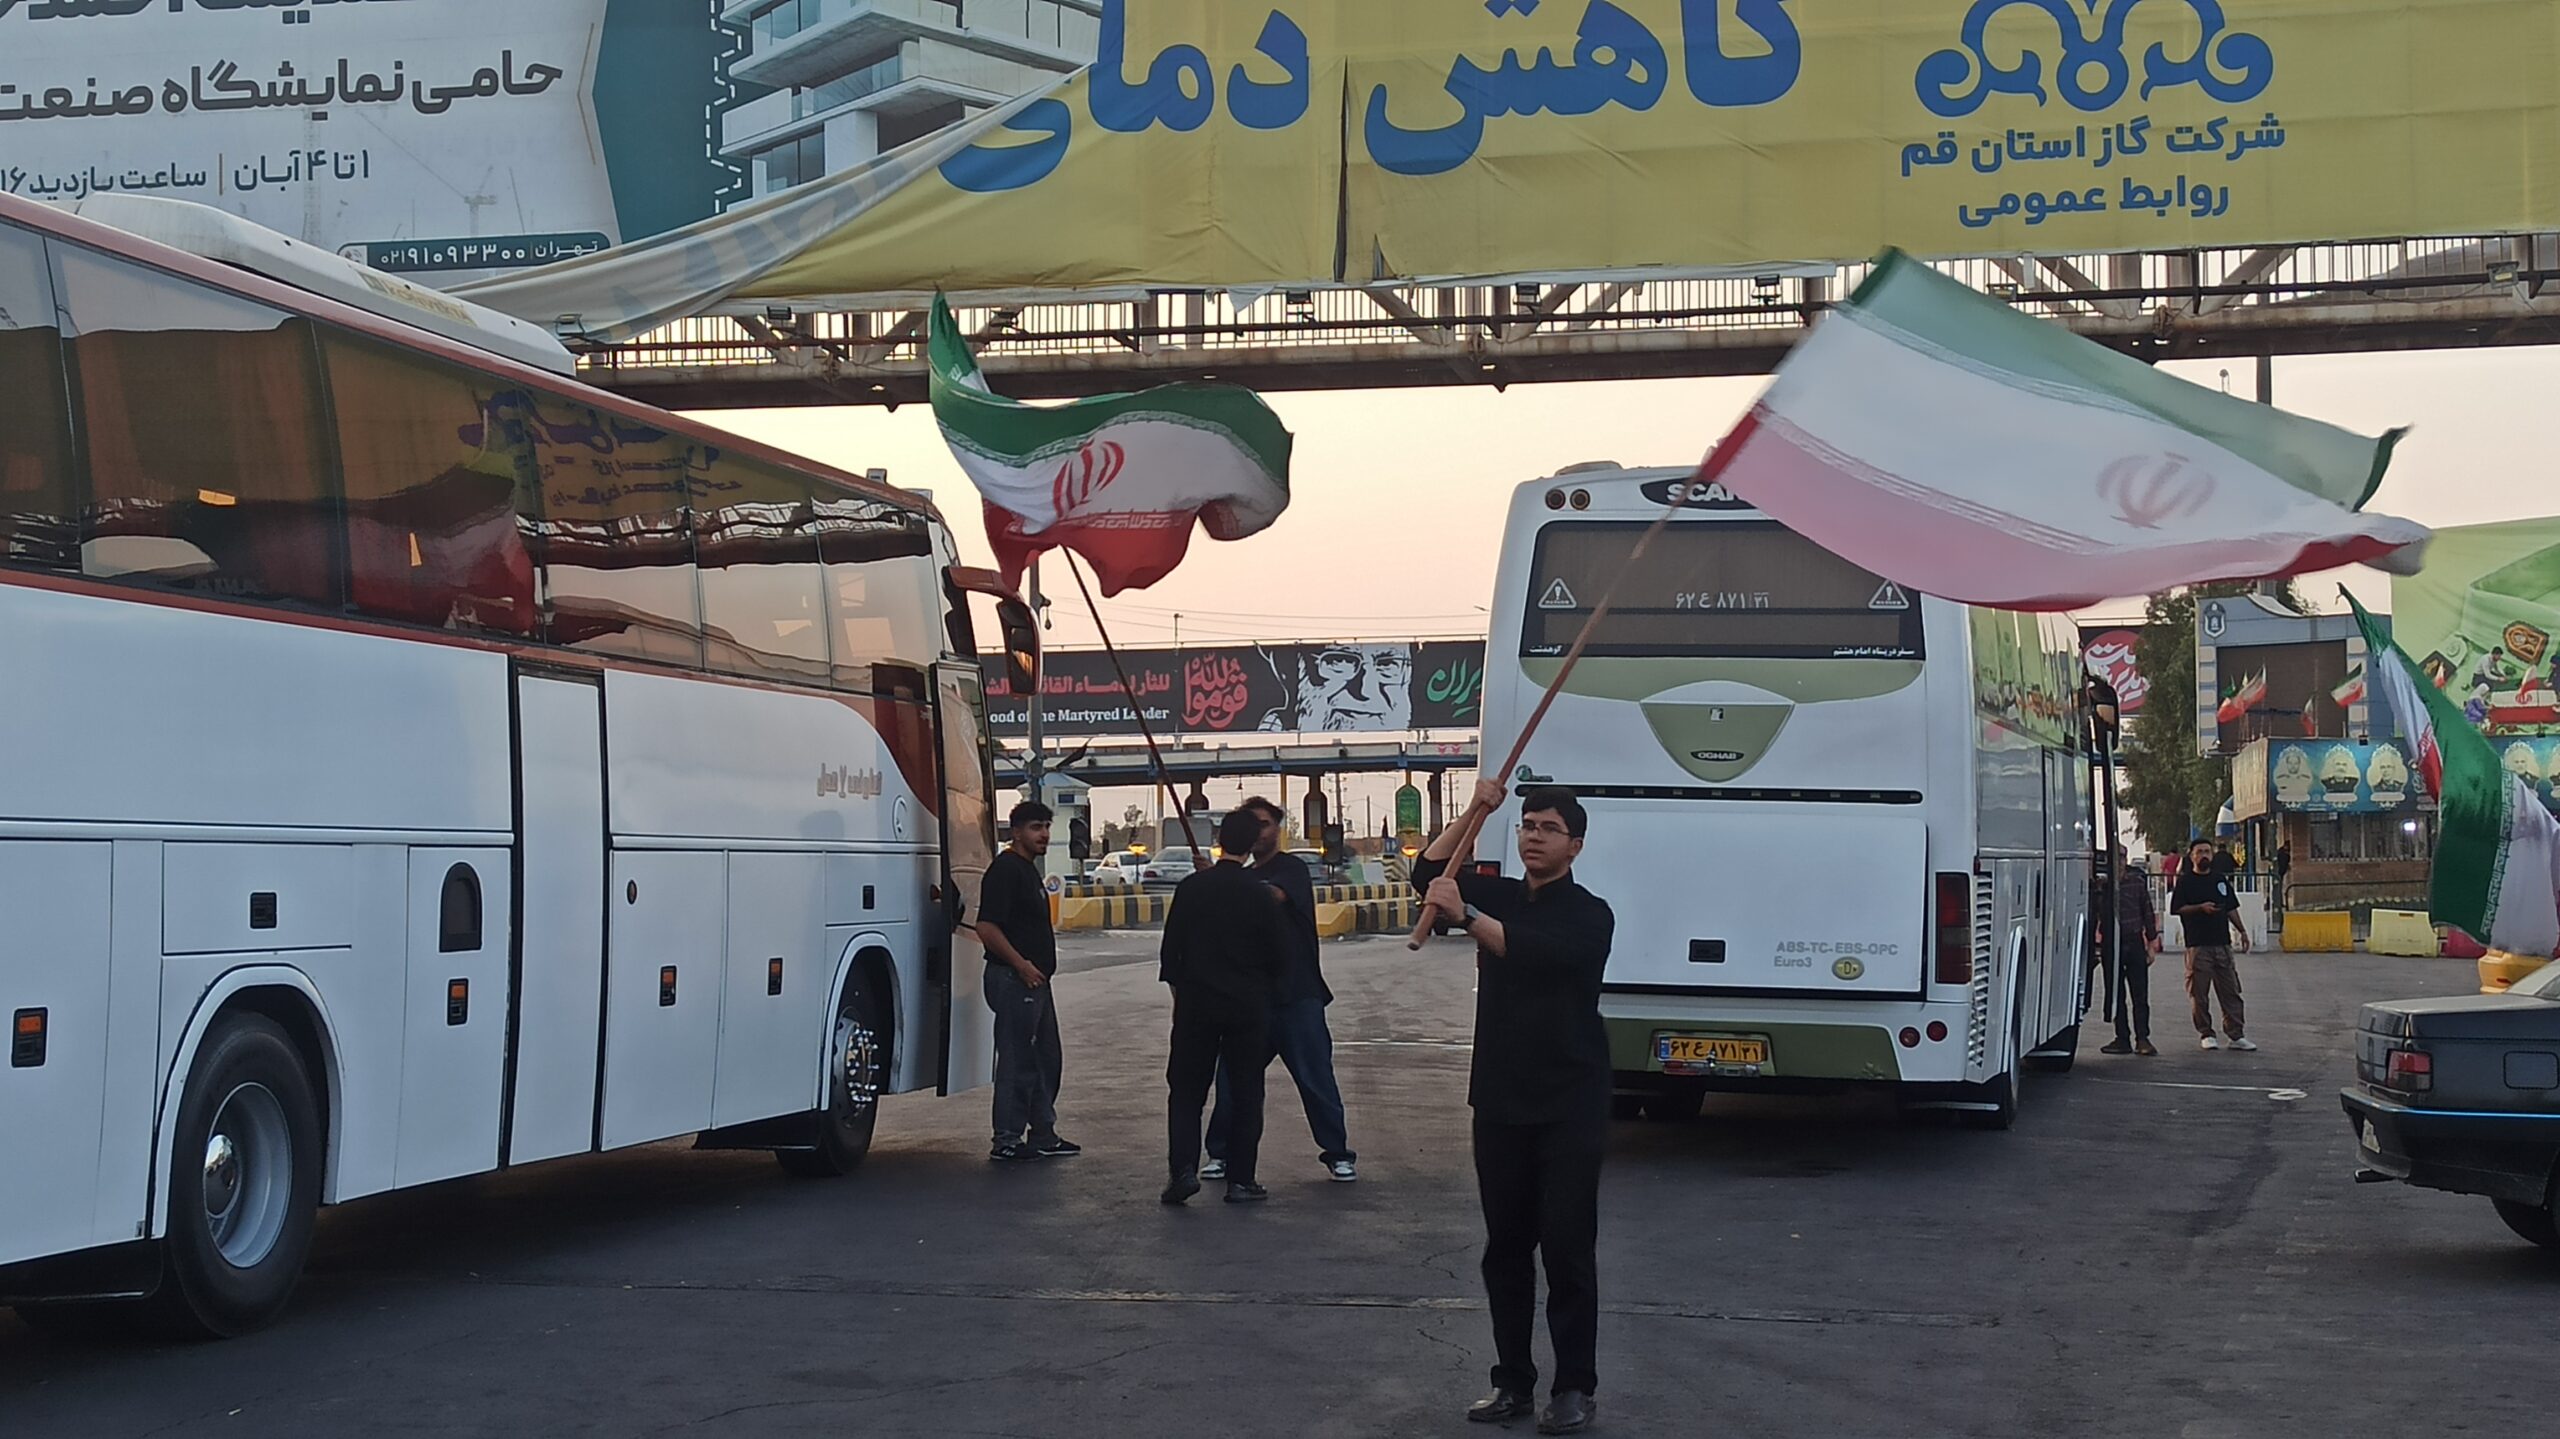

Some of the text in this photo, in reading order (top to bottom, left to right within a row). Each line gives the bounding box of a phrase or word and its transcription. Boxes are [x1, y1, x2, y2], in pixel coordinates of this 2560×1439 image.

[0, 50, 563, 121] حامی نمایشگاه صنعت
[1901, 113, 2286, 176] شرکت گاز استان قم
[119, 163, 207, 190] ساعت
[233, 150, 301, 191] آبان
[307, 150, 328, 180] ۴
[333, 151, 356, 179] تا
[29, 166, 114, 201] بازدید
[1959, 175, 2229, 227] روابط عمومی
[535, 240, 598, 258] تهران
[1667, 483, 1735, 502] SCA
[1058, 707, 1121, 724] Martyred
[1698, 752, 1737, 760] OGHAB
[1773, 955, 1812, 968] Euro3
